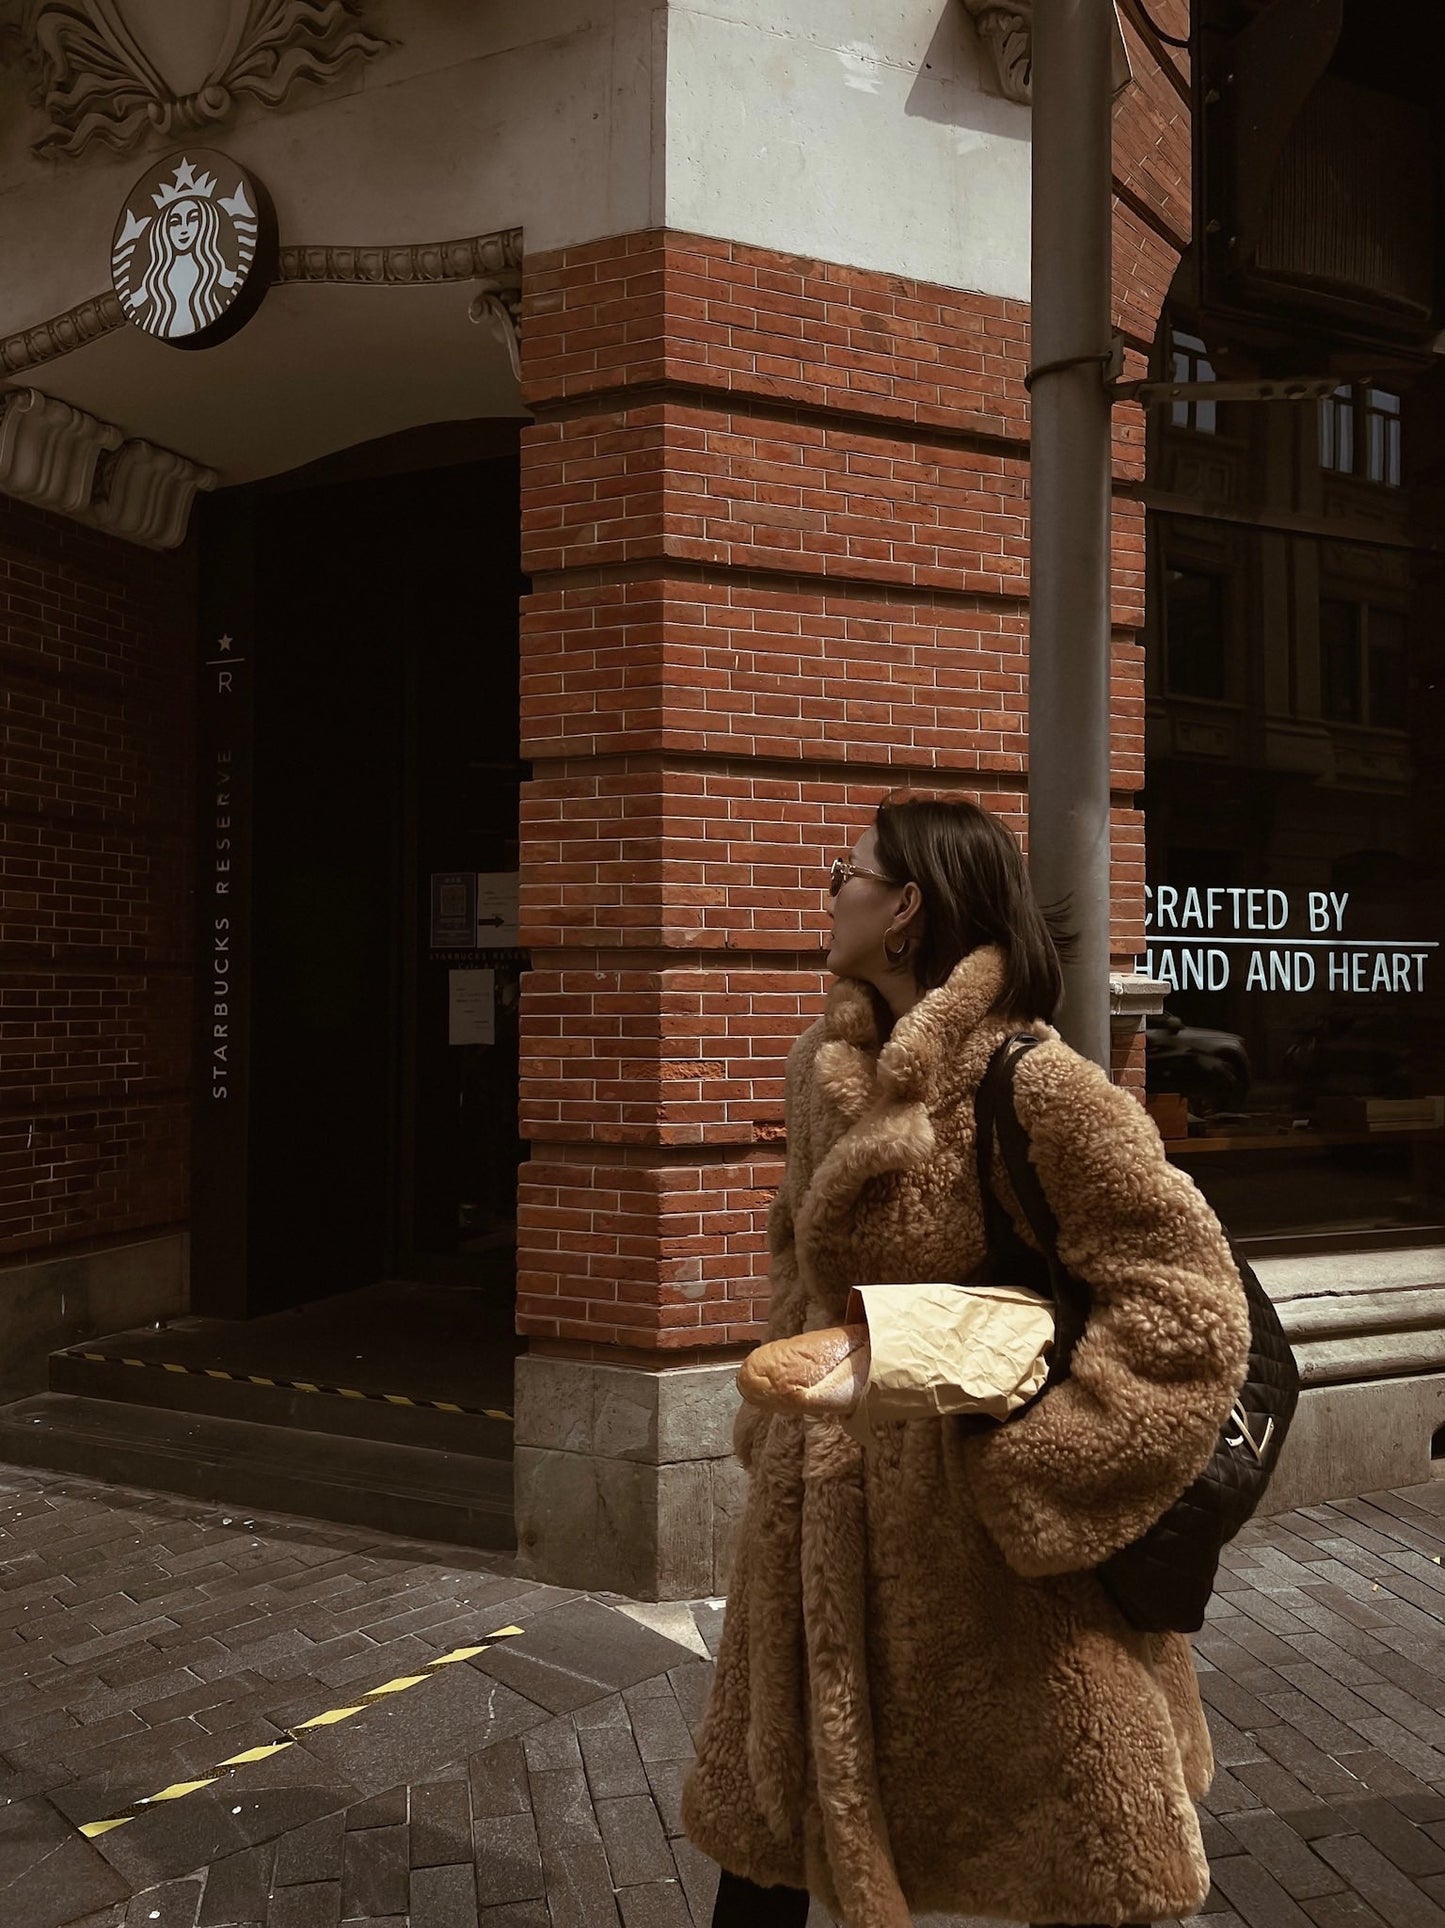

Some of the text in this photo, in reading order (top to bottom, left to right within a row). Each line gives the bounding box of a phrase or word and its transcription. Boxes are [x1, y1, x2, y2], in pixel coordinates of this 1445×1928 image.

[218, 671, 233, 694] R
[212, 749, 232, 1099] STARBUCKS RESERVE
[1308, 891, 1350, 933] BY
[1133, 947, 1430, 993] HAND AND HEART
